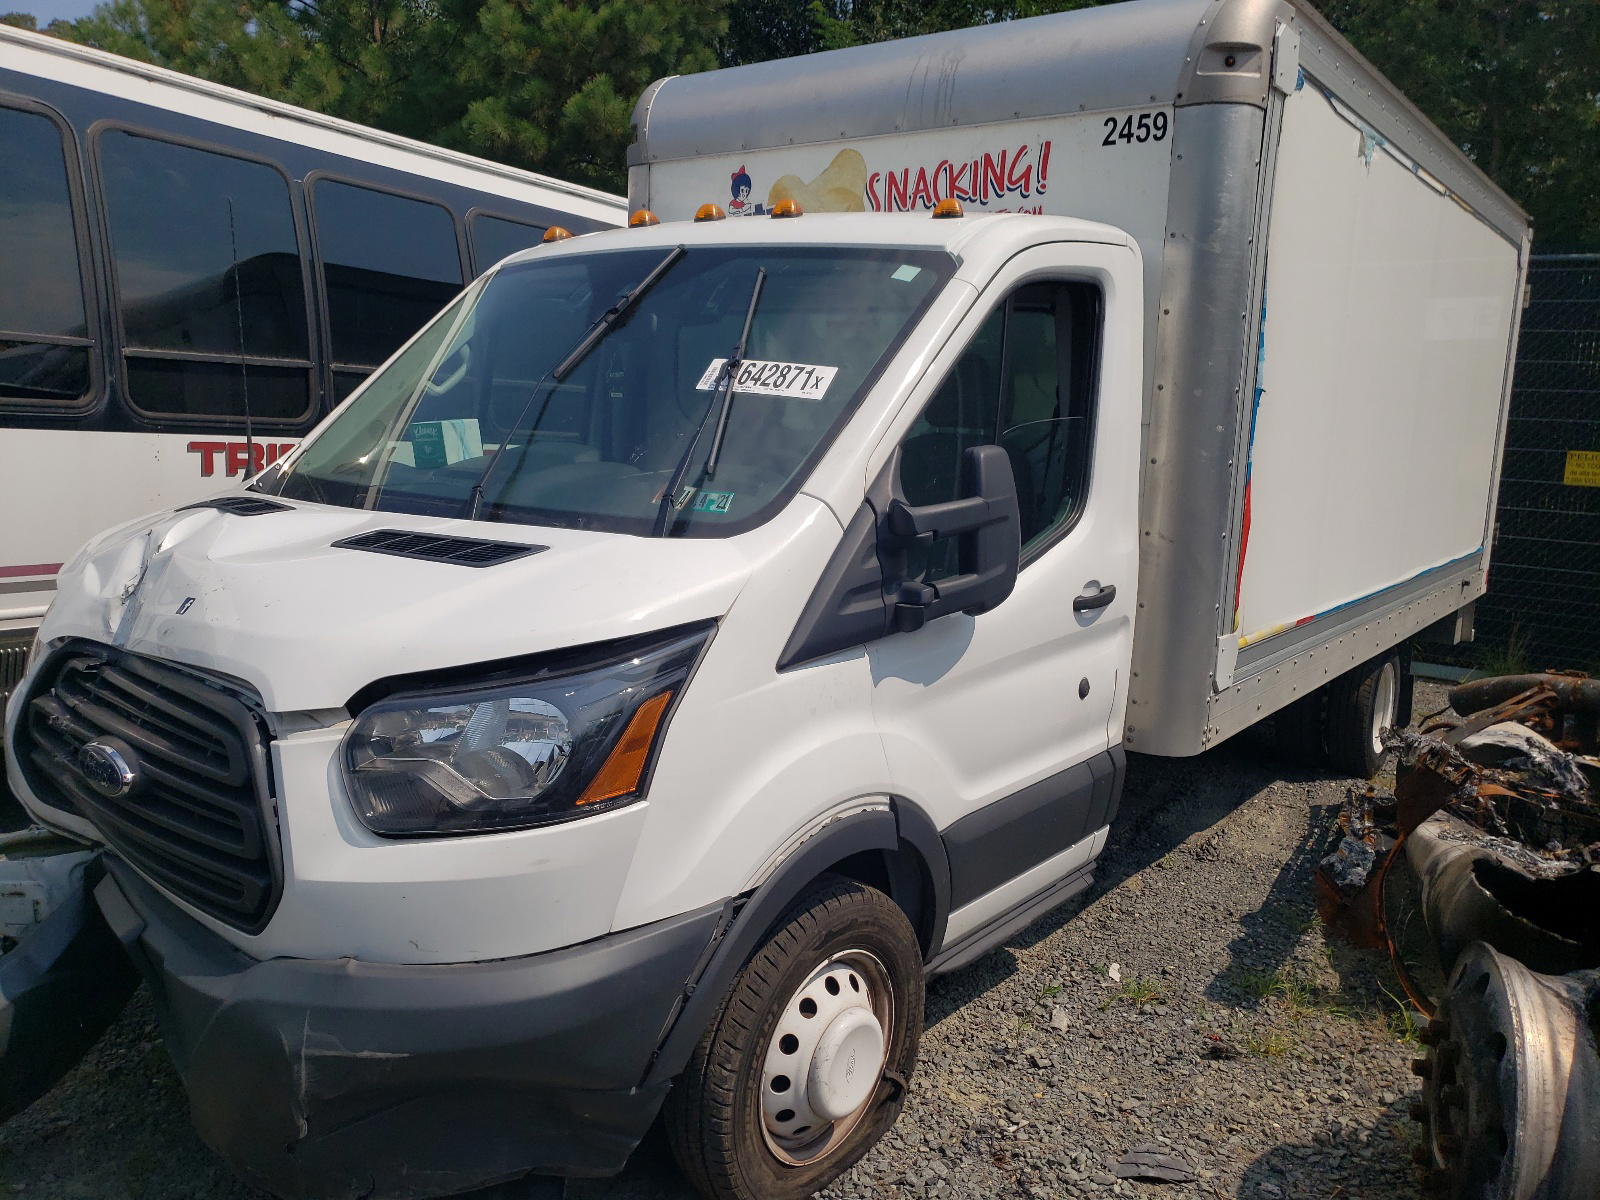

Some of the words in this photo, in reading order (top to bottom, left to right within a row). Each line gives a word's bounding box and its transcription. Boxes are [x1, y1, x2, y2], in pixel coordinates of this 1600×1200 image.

[1102, 111, 1168, 146] 2459
[866, 141, 1052, 212] SNACKING!
[187, 441, 297, 477] TRI
